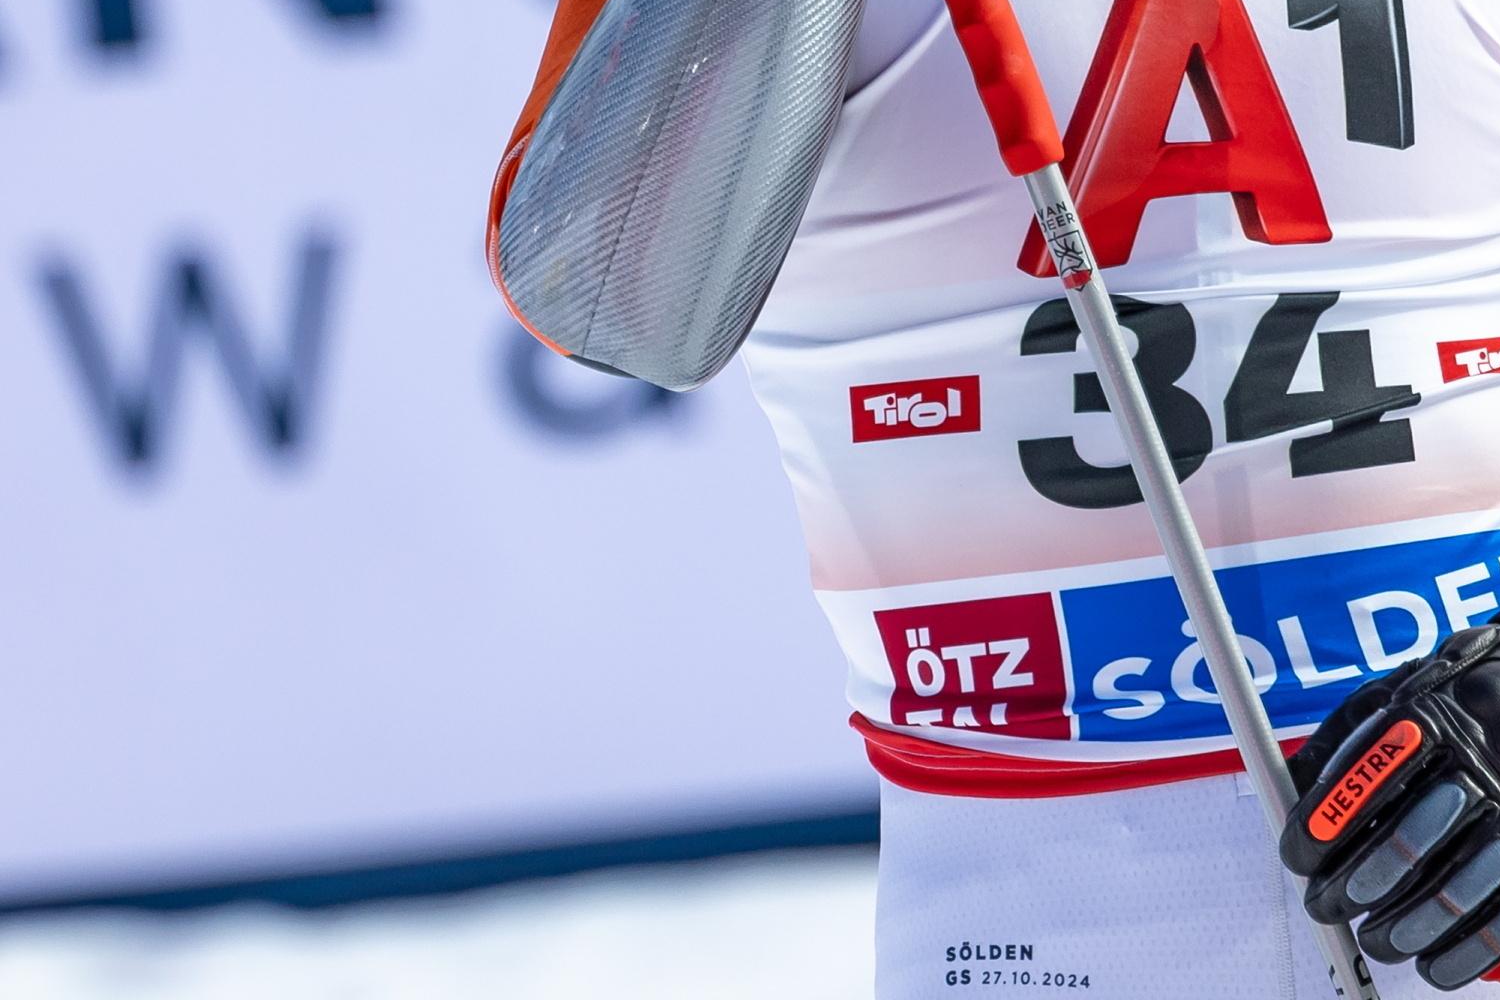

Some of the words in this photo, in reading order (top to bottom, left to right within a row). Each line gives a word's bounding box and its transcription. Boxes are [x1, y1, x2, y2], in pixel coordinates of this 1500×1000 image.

[1037, 200, 1068, 221] VAN
[863, 387, 962, 428] Tirol
[1018, 290, 1422, 509] 34
[905, 628, 1034, 697] ÖTZ
[1320, 743, 1406, 826] HESTRA
[945, 941, 1034, 962] SÖLDEN
[945, 969, 972, 986] GS
[981, 970, 1091, 989] 27.10.2024
